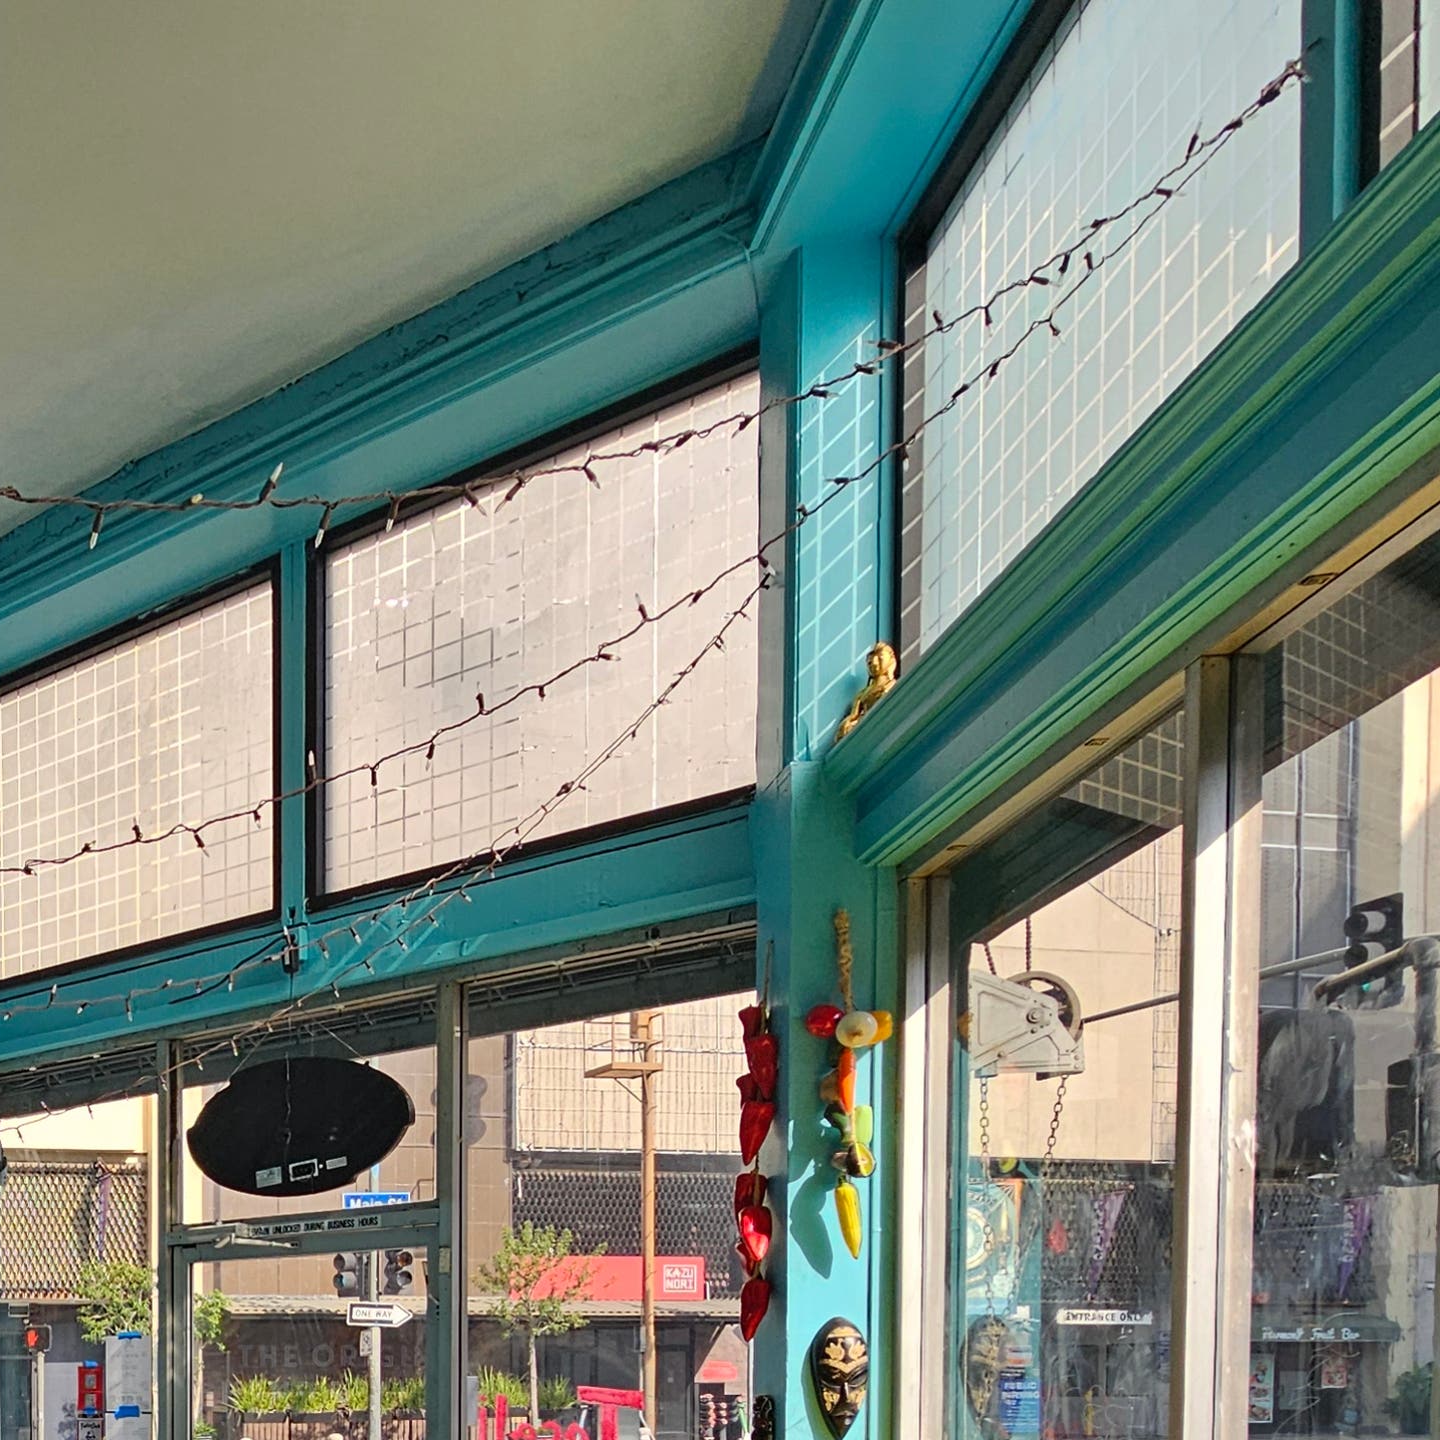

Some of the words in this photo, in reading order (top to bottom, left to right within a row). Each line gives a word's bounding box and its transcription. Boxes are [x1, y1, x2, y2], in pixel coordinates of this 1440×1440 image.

[272, 1223, 301, 1234] UNLOCKED
[303, 1221, 325, 1232] DURING
[327, 1218, 355, 1230] BUSINESS
[358, 1216, 379, 1227] HOURS
[665, 1266, 694, 1278] KAZU
[665, 1279, 694, 1290] NORI
[355, 1308, 372, 1318] ONE
[375, 1308, 393, 1319] WAY
[238, 1344, 299, 1368] THE
